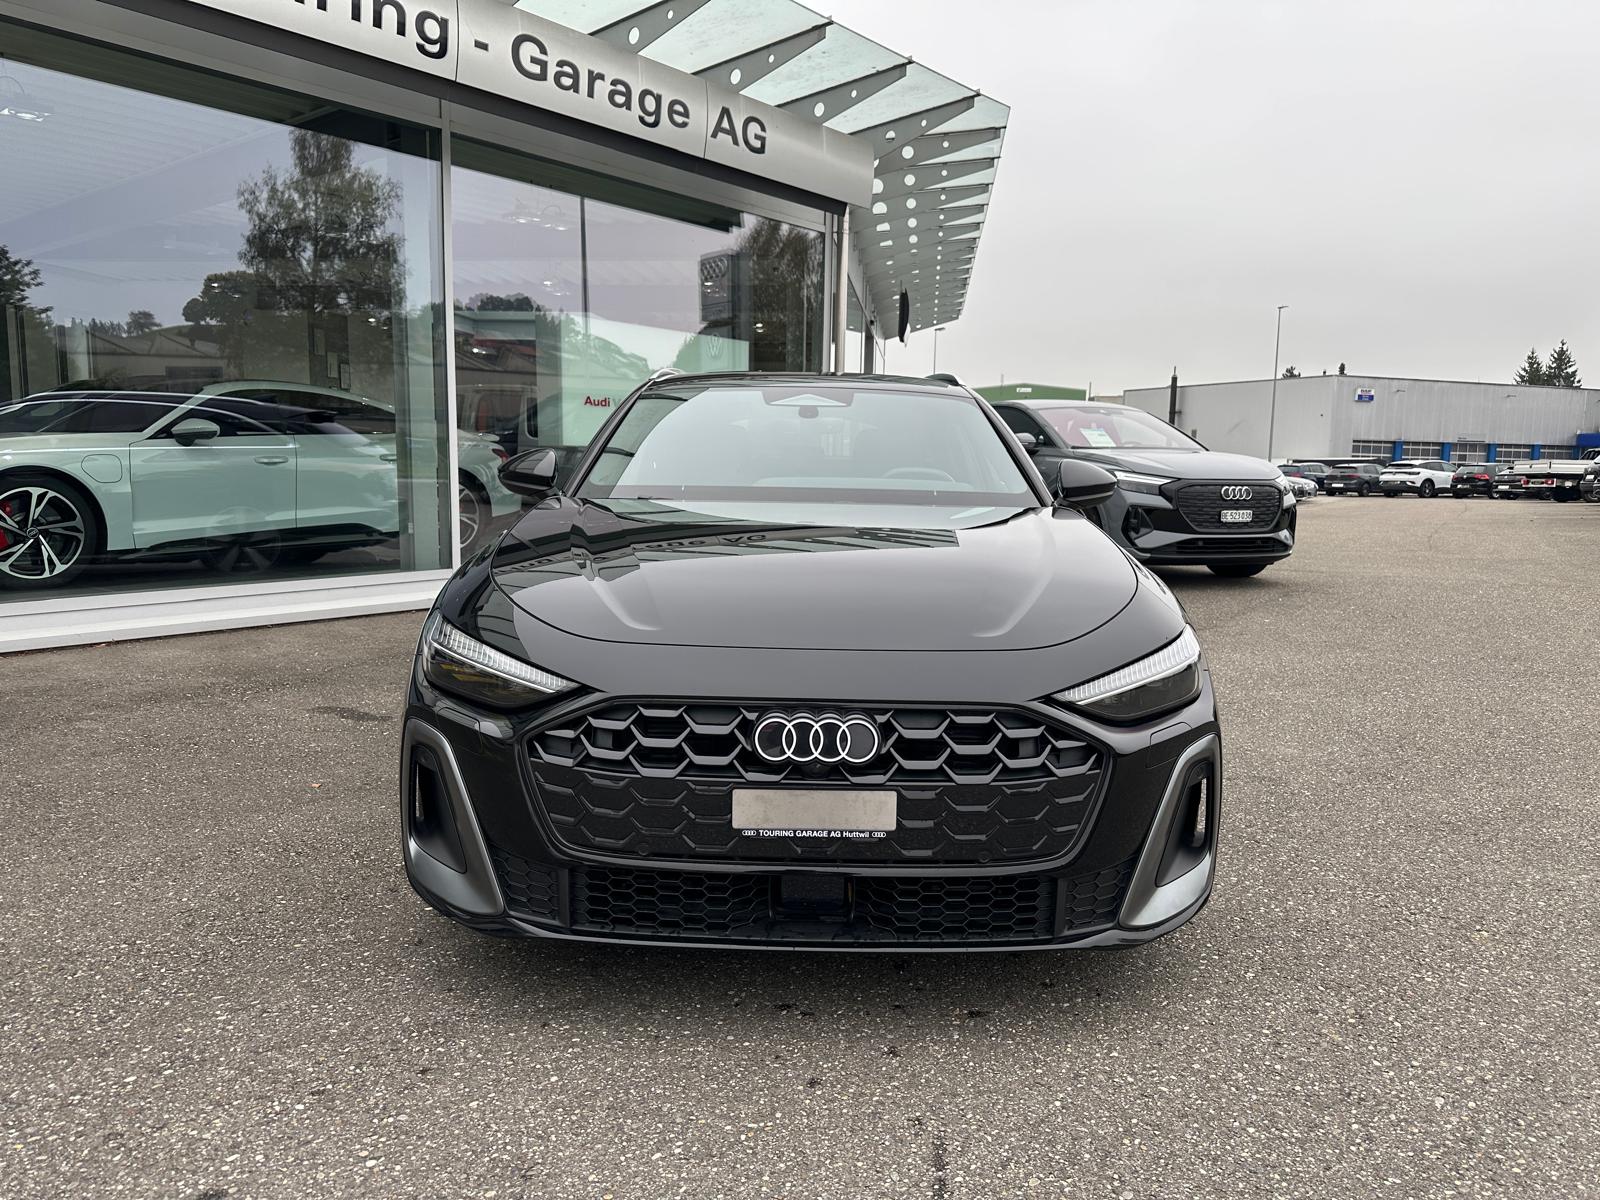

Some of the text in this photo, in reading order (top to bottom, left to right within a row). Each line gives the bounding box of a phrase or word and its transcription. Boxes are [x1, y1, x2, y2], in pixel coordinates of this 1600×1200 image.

[474, 38, 489, 52] -
[511, 33, 691, 129] Garage
[710, 106, 767, 155] AG
[584, 395, 611, 407] Audi
[796, 830, 828, 838] GARAGE
